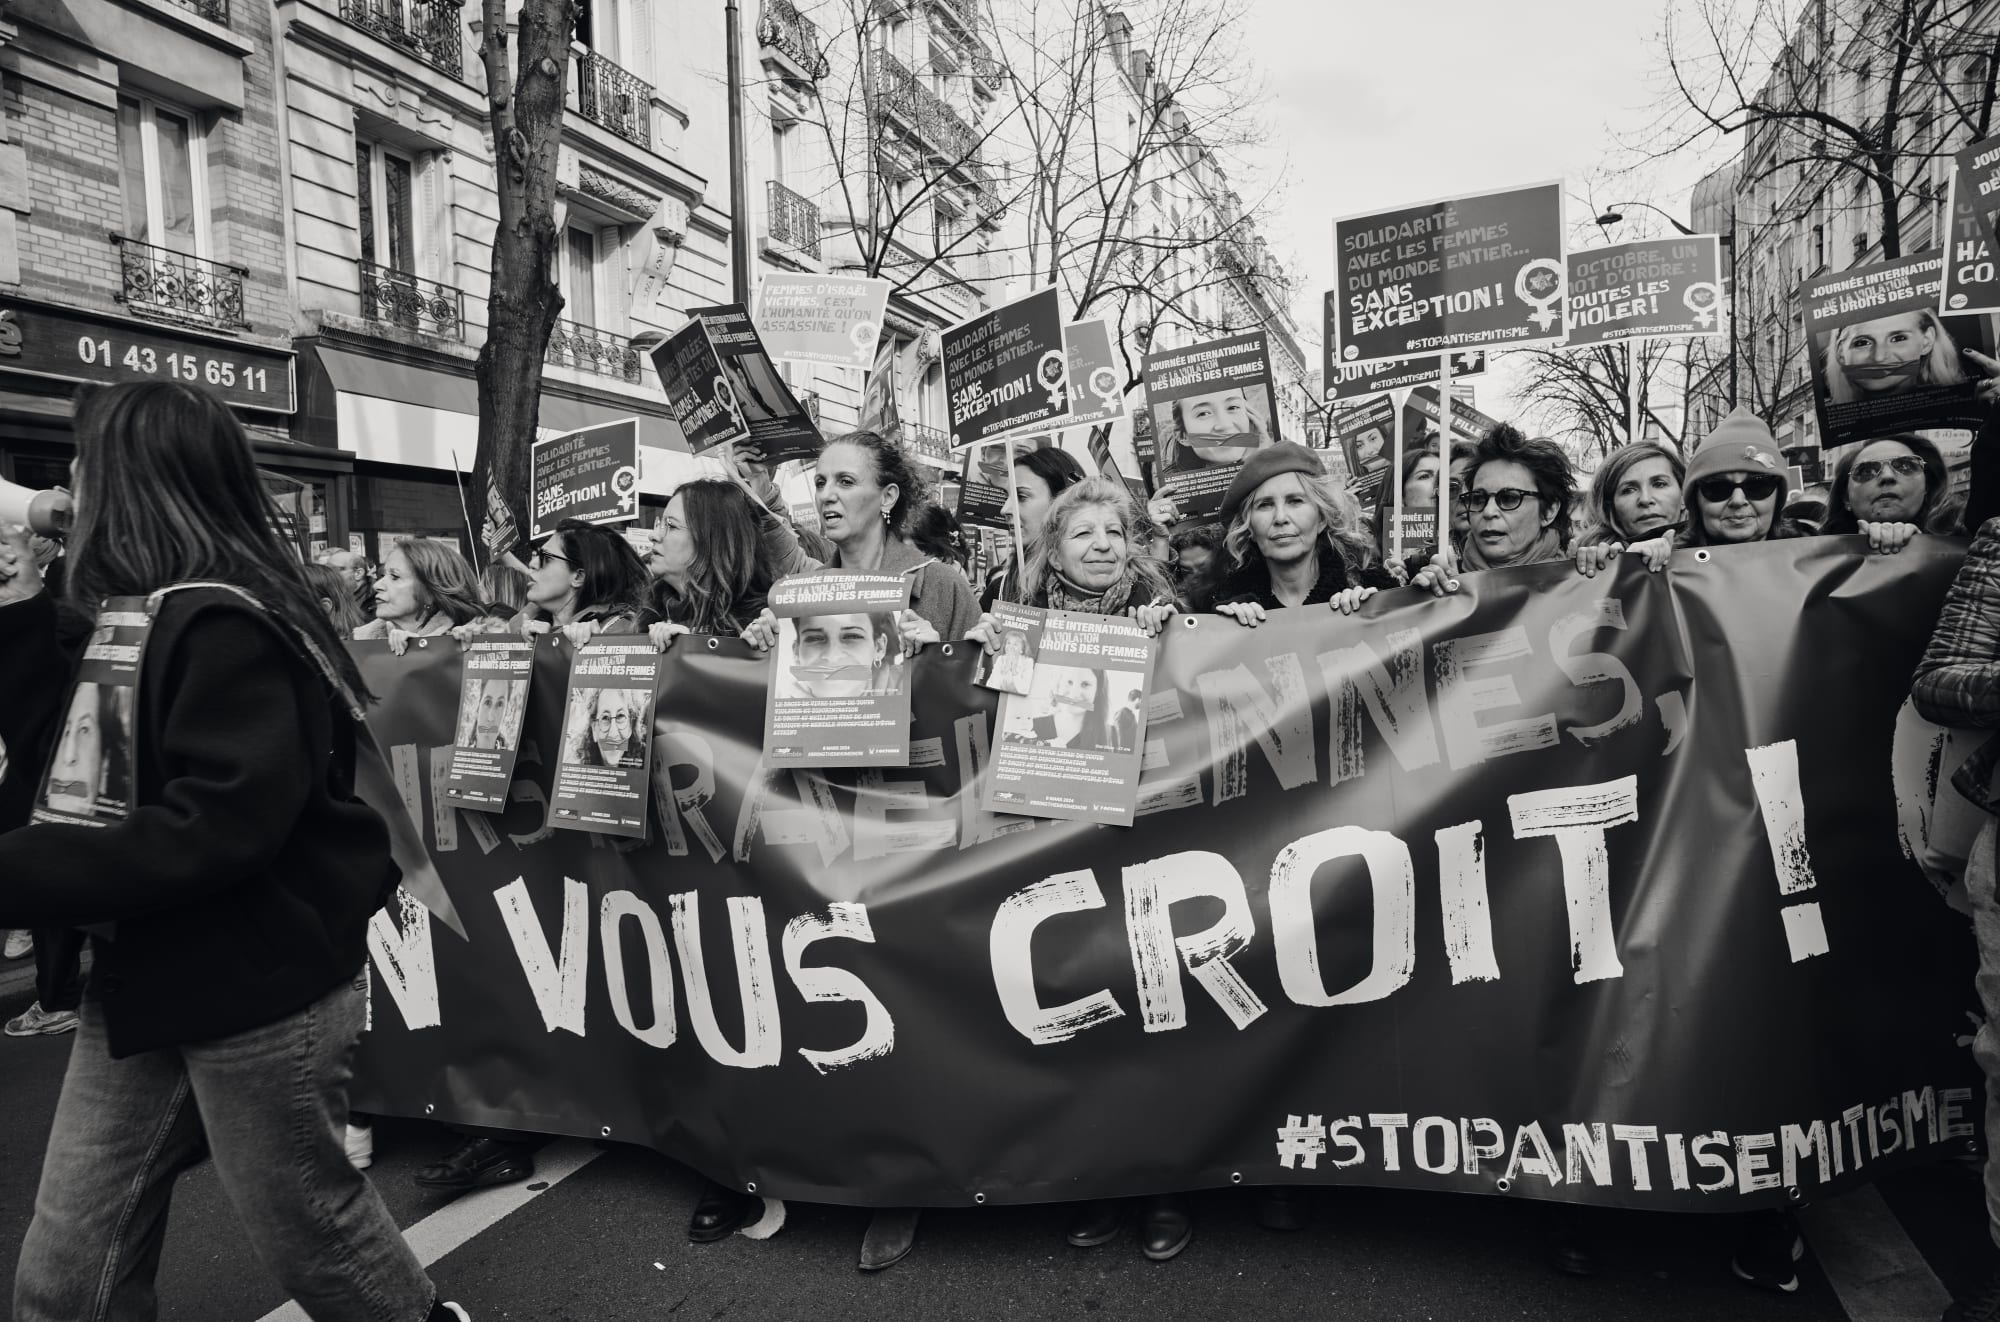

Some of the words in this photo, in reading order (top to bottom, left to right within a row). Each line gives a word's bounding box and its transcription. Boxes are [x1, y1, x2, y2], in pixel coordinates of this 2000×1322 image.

[1344, 208, 1459, 252] SOLIDARITÉ
[1347, 248, 1392, 272] AVEC
[1397, 240, 1426, 261] LES
[1432, 222, 1509, 252] FEMMES
[1348, 273, 1372, 291] DU
[1378, 259, 1440, 285] MONDE
[1446, 242, 1530, 271] ENTIER...
[1577, 250, 1665, 277] OCTOBRE,
[1672, 244, 1698, 259] UN
[1606, 263, 1684, 286] D'ORDRE
[766, 285, 812, 295] FEMMES
[816, 284, 868, 297] D'ISRAËL
[1350, 283, 1414, 314] SANS
[1637, 279, 1670, 297] LES
[1810, 276, 1865, 298] JOURNÉE
[1839, 293, 1852, 306] LA
[1854, 275, 1910, 299] VIOLATION
[765, 296, 820, 307] VICTIMES,
[1813, 304, 1839, 320] DES
[1840, 292, 1886, 313] DROITS
[1888, 287, 1914, 304] DES
[762, 306, 831, 319] L'HUMANITÉ
[834, 308, 871, 321] QU'ON
[761, 320, 837, 333] ASSASSINE
[946, 315, 1002, 359] SOLIDARITÉ
[1406, 326, 1529, 350] #STOPANTISEMITISME
[1602, 324, 1695, 339] #STOPANTISEMITISME
[949, 355, 970, 374] AVEC
[971, 345, 987, 363] LES
[988, 323, 1031, 353] FEMMES
[1149, 355, 1187, 372] JOURNÉE
[1187, 340, 1261, 364] INTERNATIONALE
[78, 336, 111, 367] 01
[123, 345, 157, 374] 43
[166, 353, 198, 380] 15
[205, 360, 235, 386] 65
[243, 366, 266, 392] 11
[951, 375, 964, 390] DU
[964, 358, 994, 383] MONDE
[996, 340, 1044, 367] ENTIER...
[1168, 370, 1178, 380] LA
[1179, 357, 1219, 378] VIOLATION
[1150, 377, 1169, 392] DES
[1170, 371, 1202, 388] DROITS
[1203, 368, 1222, 382] DES
[952, 380, 983, 409] SANS
[982, 408, 1049, 435] #STOPANTISEMITISME
[536, 435, 586, 465] SOLIDARITÉ
[537, 462, 555, 477] AVEC
[556, 456, 570, 469] LES
[572, 444, 610, 463] FEMMES
[537, 479, 547, 490] DU
[549, 467, 576, 485] MONDE
[578, 457, 620, 474] ENTIER...
[537, 483, 564, 505] SANS
[1389, 530, 1405, 538] DS
[1406, 530, 1434, 538] DROITS
[780, 575, 823, 586] JOURNÉE
[823, 575, 906, 584] INTERNATIONALE
[810, 582, 856, 595] VIOLATION
[776, 595, 795, 604] DES
[797, 592, 834, 604] DROITS
[835, 590, 856, 600] DES
[1003, 619, 1029, 630] JAMAIS
[1066, 619, 1150, 639] INTERNATIONALE
[1039, 639, 1077, 653] DROITS
[1078, 643, 1100, 655] DES
[1054, 632, 1100, 644] VIOLATION
[606, 645, 658, 655] INTERNATIONALE
[468, 660, 479, 669] DES
[499, 660, 509, 669] DES
[575, 665, 588, 675] DES
[588, 665, 611, 675] DROITS
[612, 665, 626, 675] DES
[493, 874, 896, 1077] VOUS
[989, 774, 1638, 1046] CROIT
[1745, 739, 1829, 963] !
[1276, 1085, 1976, 1194] #STOPANTISEMITISME
